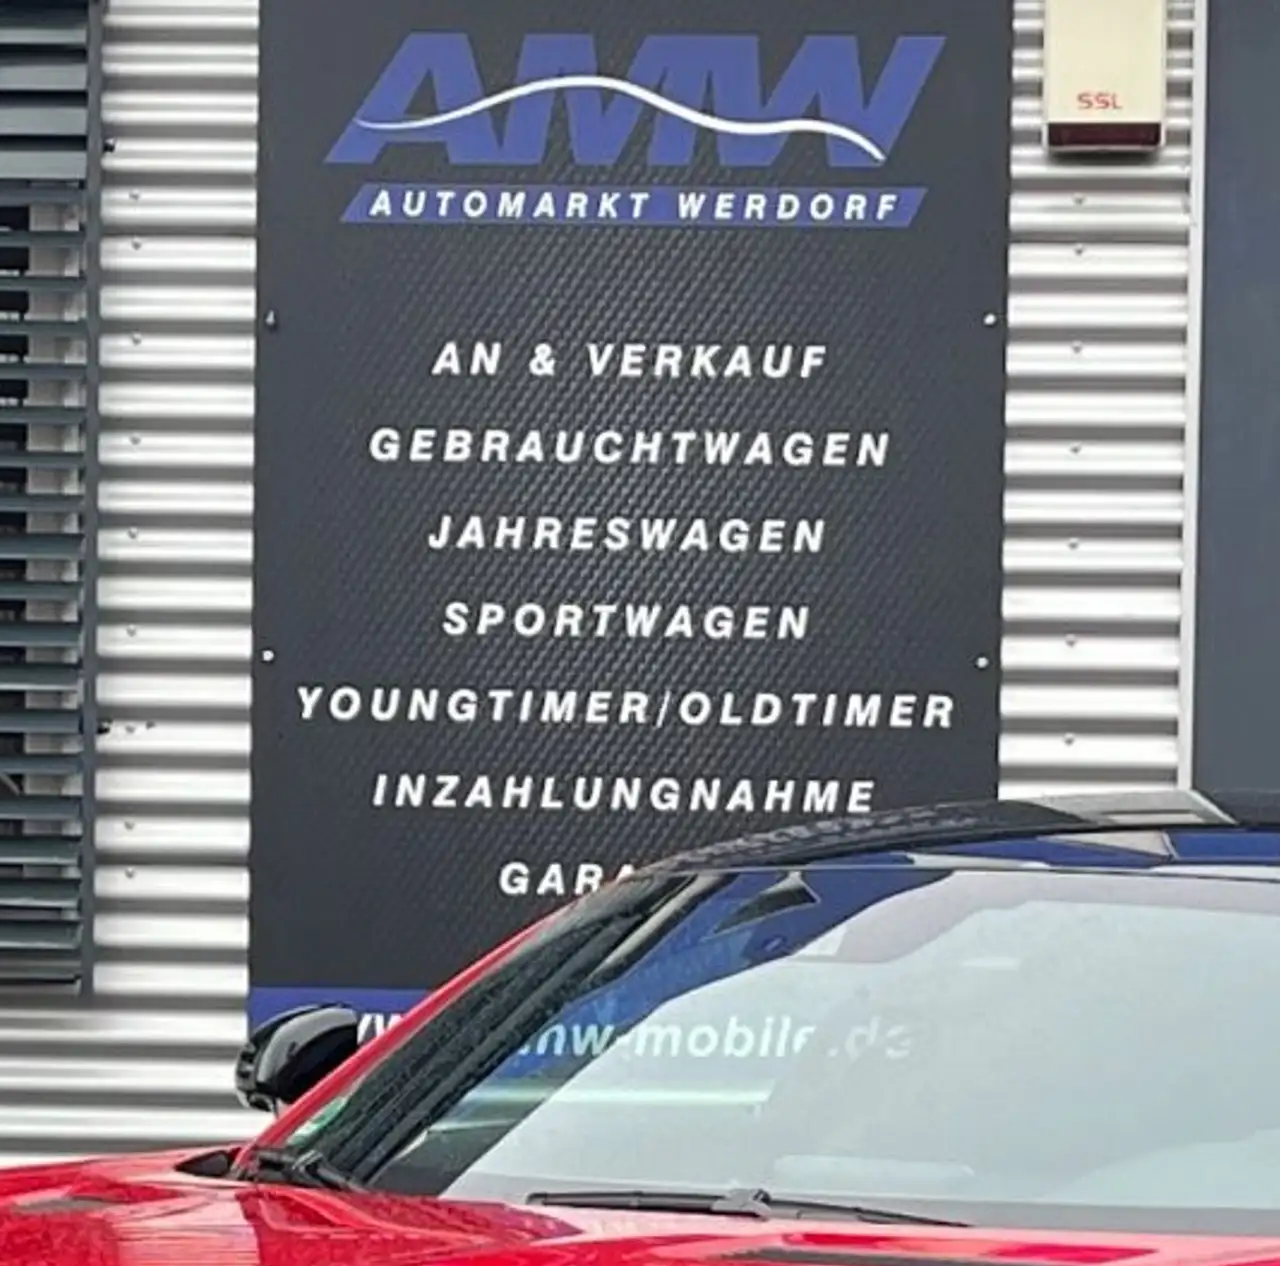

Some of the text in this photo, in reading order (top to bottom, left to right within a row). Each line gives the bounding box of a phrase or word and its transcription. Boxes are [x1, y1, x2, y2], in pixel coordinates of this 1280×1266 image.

[326, 32, 945, 168] AMW
[1076, 92, 1123, 110] SSL
[369, 189, 898, 222] AUTOMARKT WERDORF
[432, 341, 827, 379] AN & VERKAUF
[369, 427, 890, 468] GEBRAUCHTWAGEN
[427, 515, 826, 554] JAHRESWAGEN
[442, 601, 809, 640] SPORTWAGEN
[297, 686, 955, 729] YOUNGTIMER/OLDTIMER
[372, 774, 875, 813] INZAHLUNGNAHME
